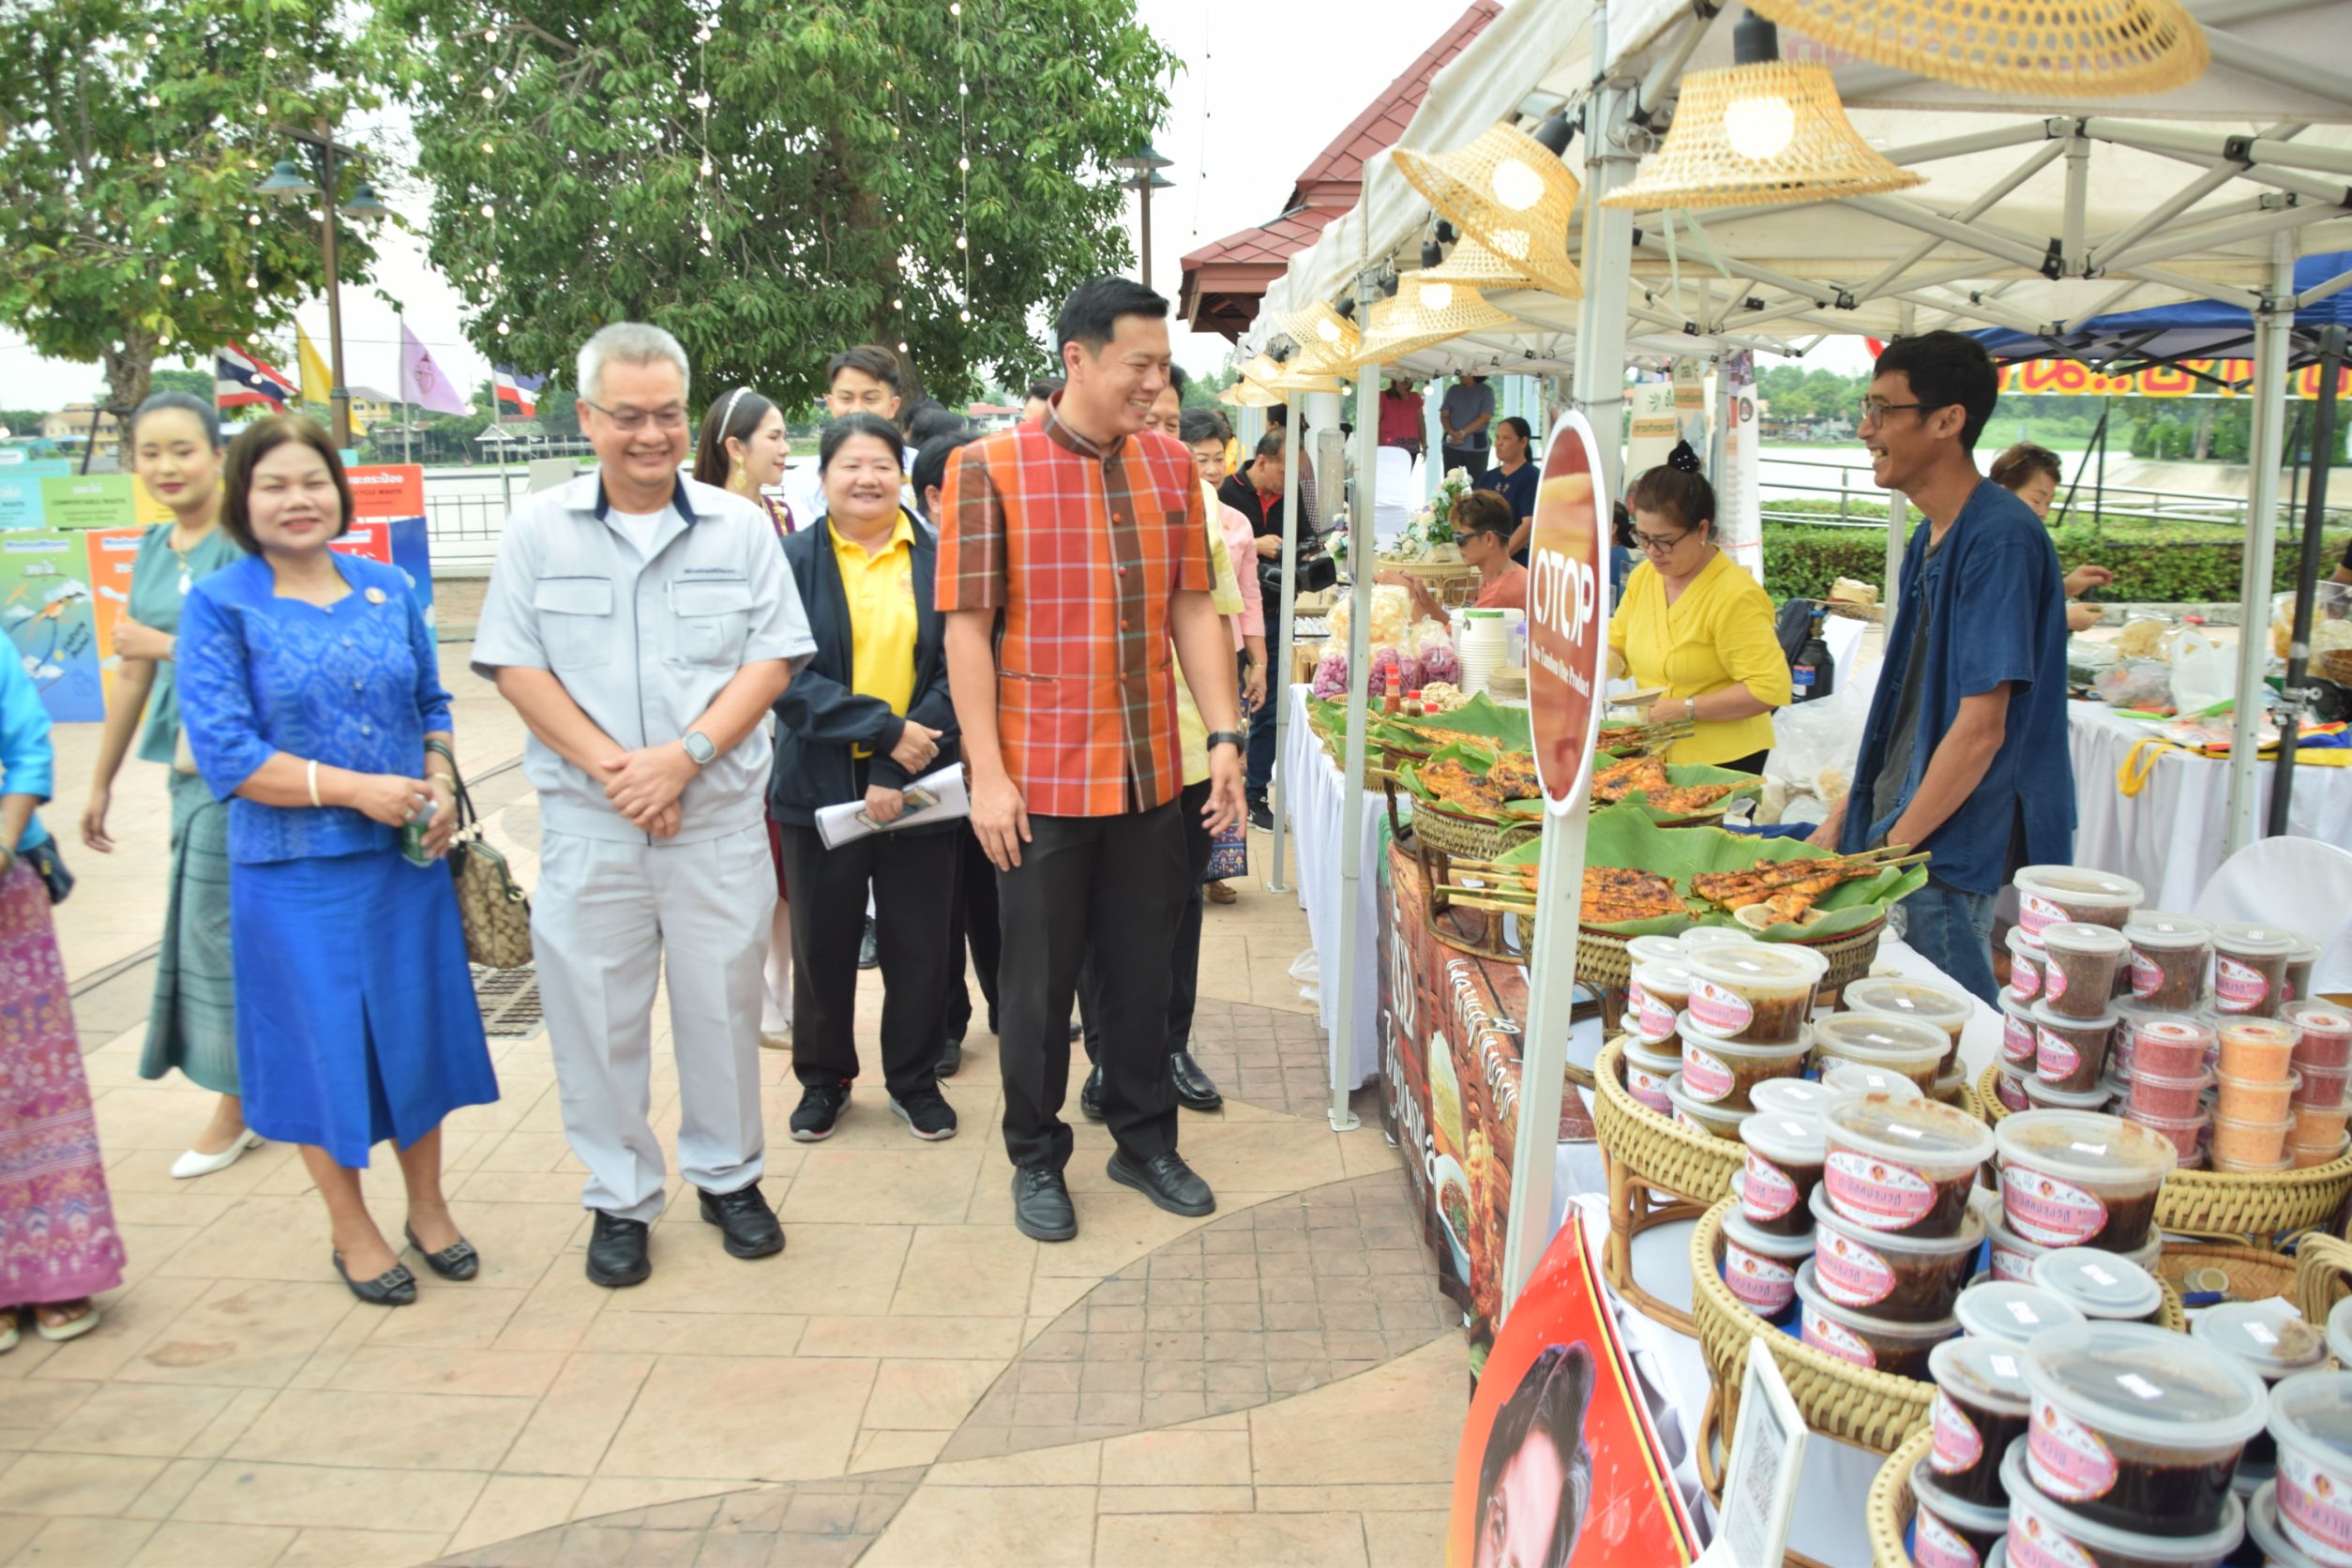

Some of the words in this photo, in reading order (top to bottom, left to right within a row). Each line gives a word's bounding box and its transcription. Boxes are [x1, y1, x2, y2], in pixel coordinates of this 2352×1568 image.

[1533, 548, 1594, 647] OTOP
[1530, 641, 1541, 663] One
[1558, 658, 1569, 684] One
[1568, 665, 1591, 699] Product
